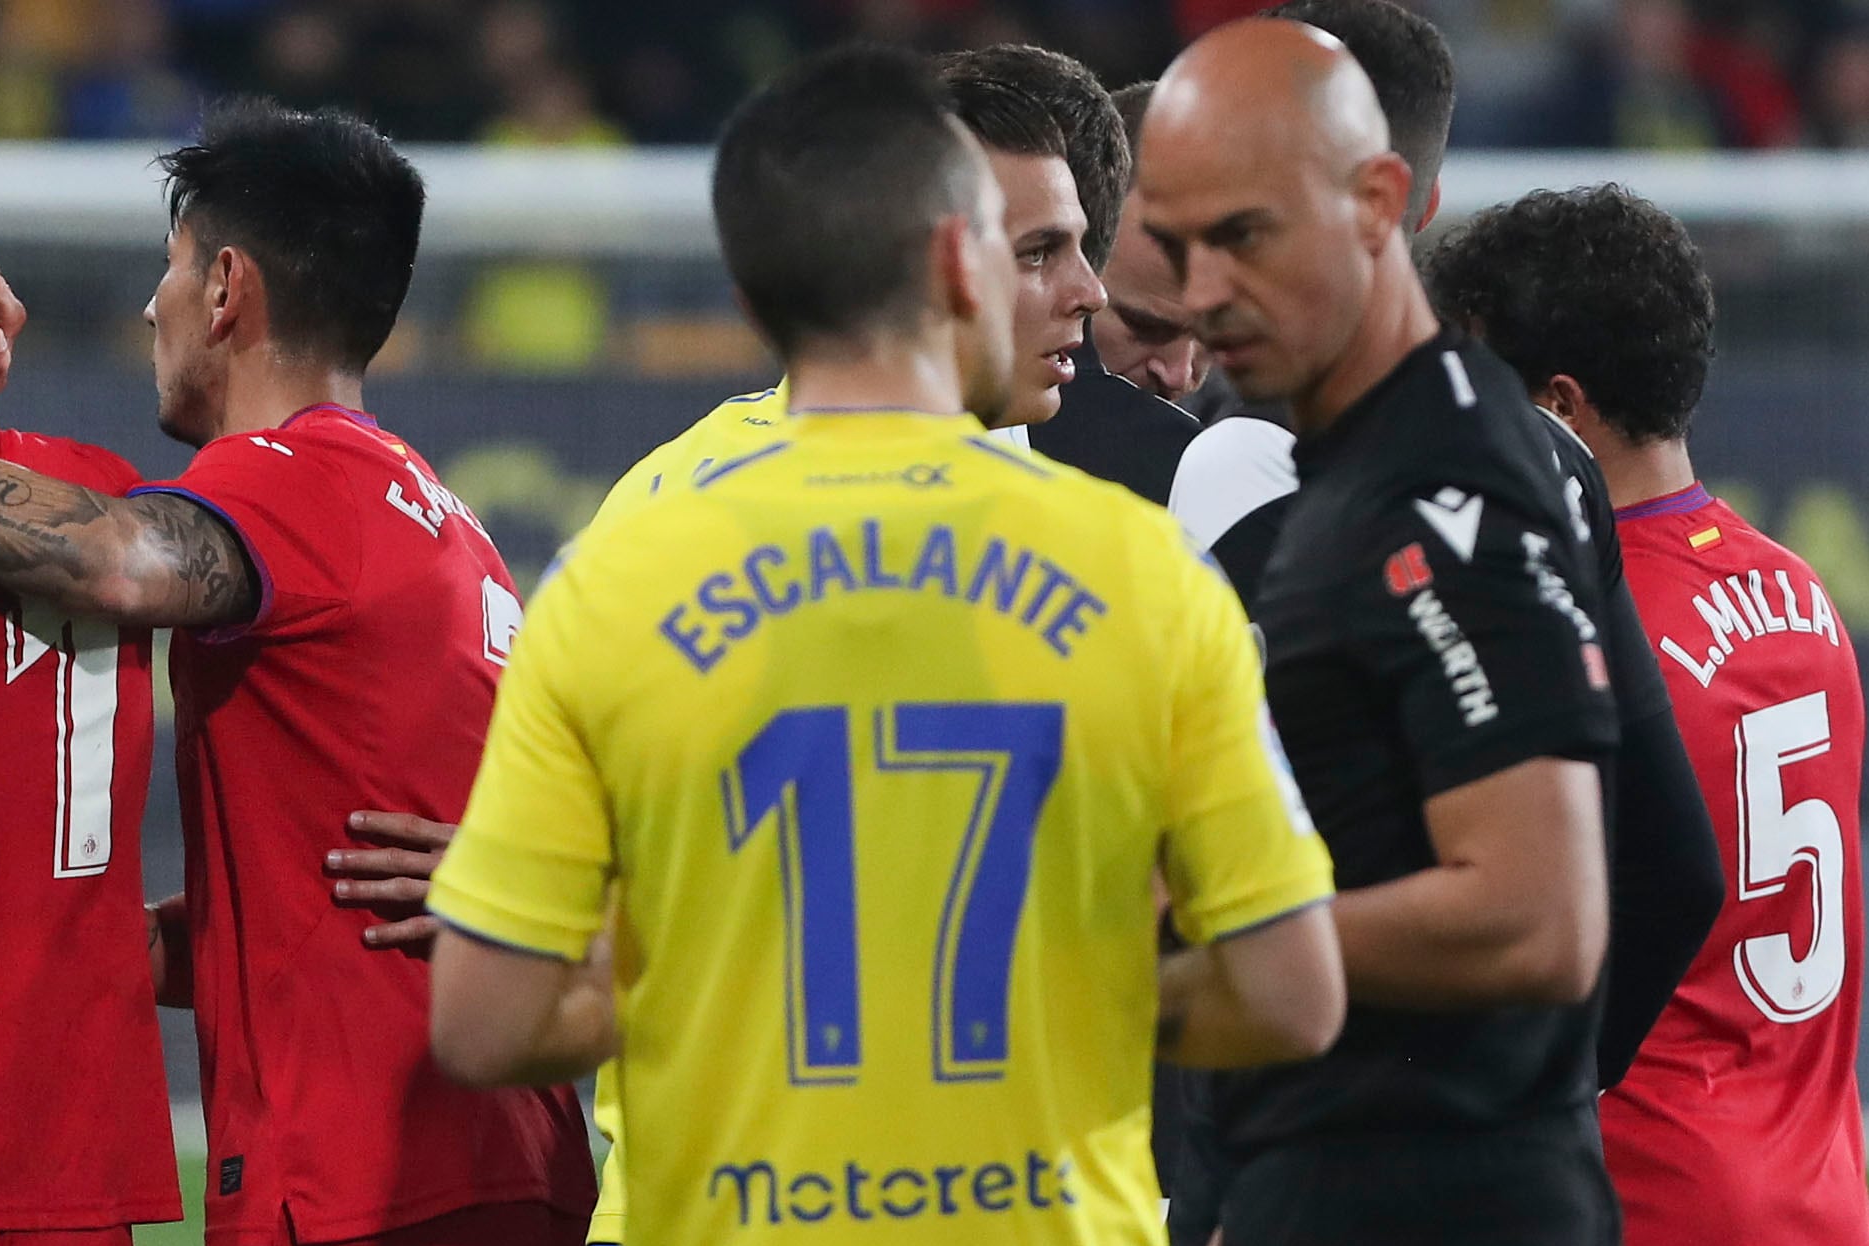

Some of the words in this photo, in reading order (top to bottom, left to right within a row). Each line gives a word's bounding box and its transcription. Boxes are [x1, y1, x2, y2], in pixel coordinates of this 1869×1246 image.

[658, 519, 1107, 674] ESCALANTE
[1659, 568, 1840, 689] L.MILLA
[719, 701, 1067, 1087] 17
[1733, 690, 1846, 1024] 5
